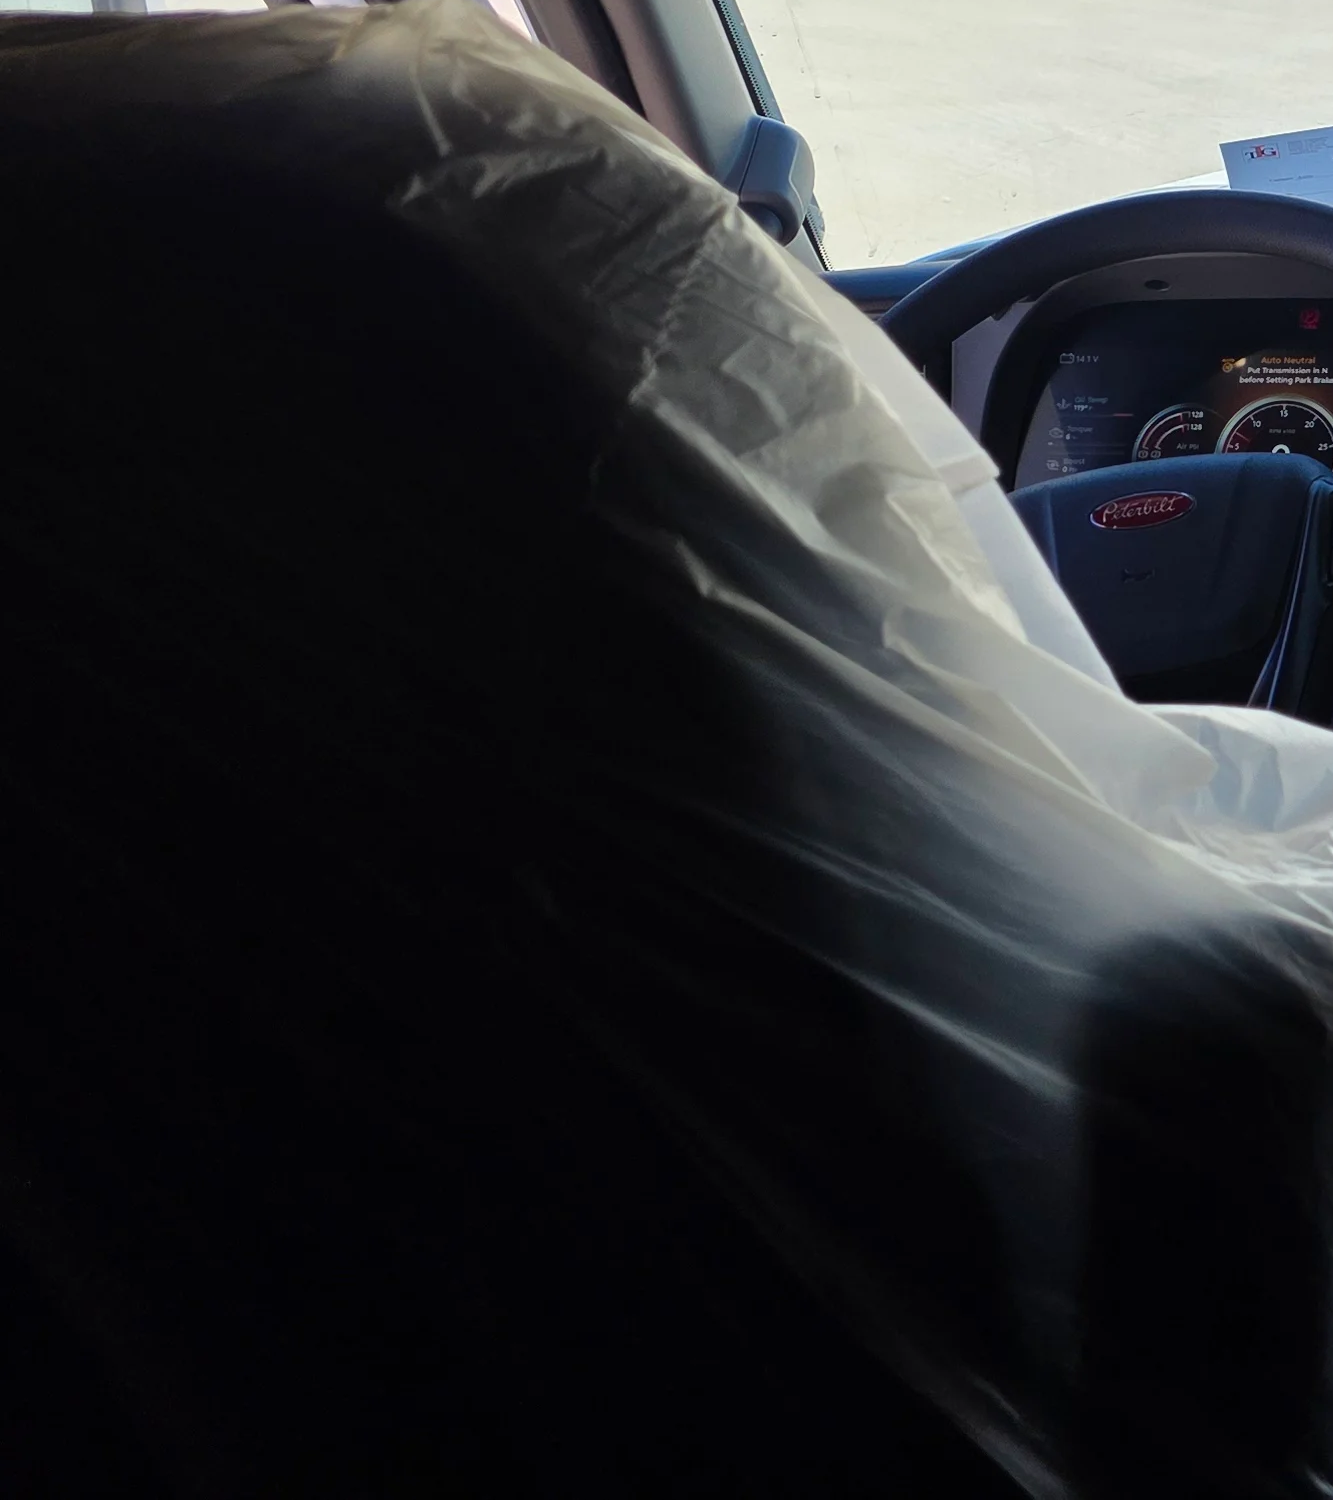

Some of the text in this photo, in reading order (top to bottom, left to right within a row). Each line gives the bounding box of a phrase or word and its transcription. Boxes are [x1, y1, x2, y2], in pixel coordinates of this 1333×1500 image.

[1284, 356, 1316, 364] Neutral
[1239, 376, 1264, 384] before
[1266, 377, 1293, 385] Setting
[1280, 409, 1288, 417] 15
[1304, 420, 1315, 428] 20
[1103, 496, 1184, 523] Peterbilt
